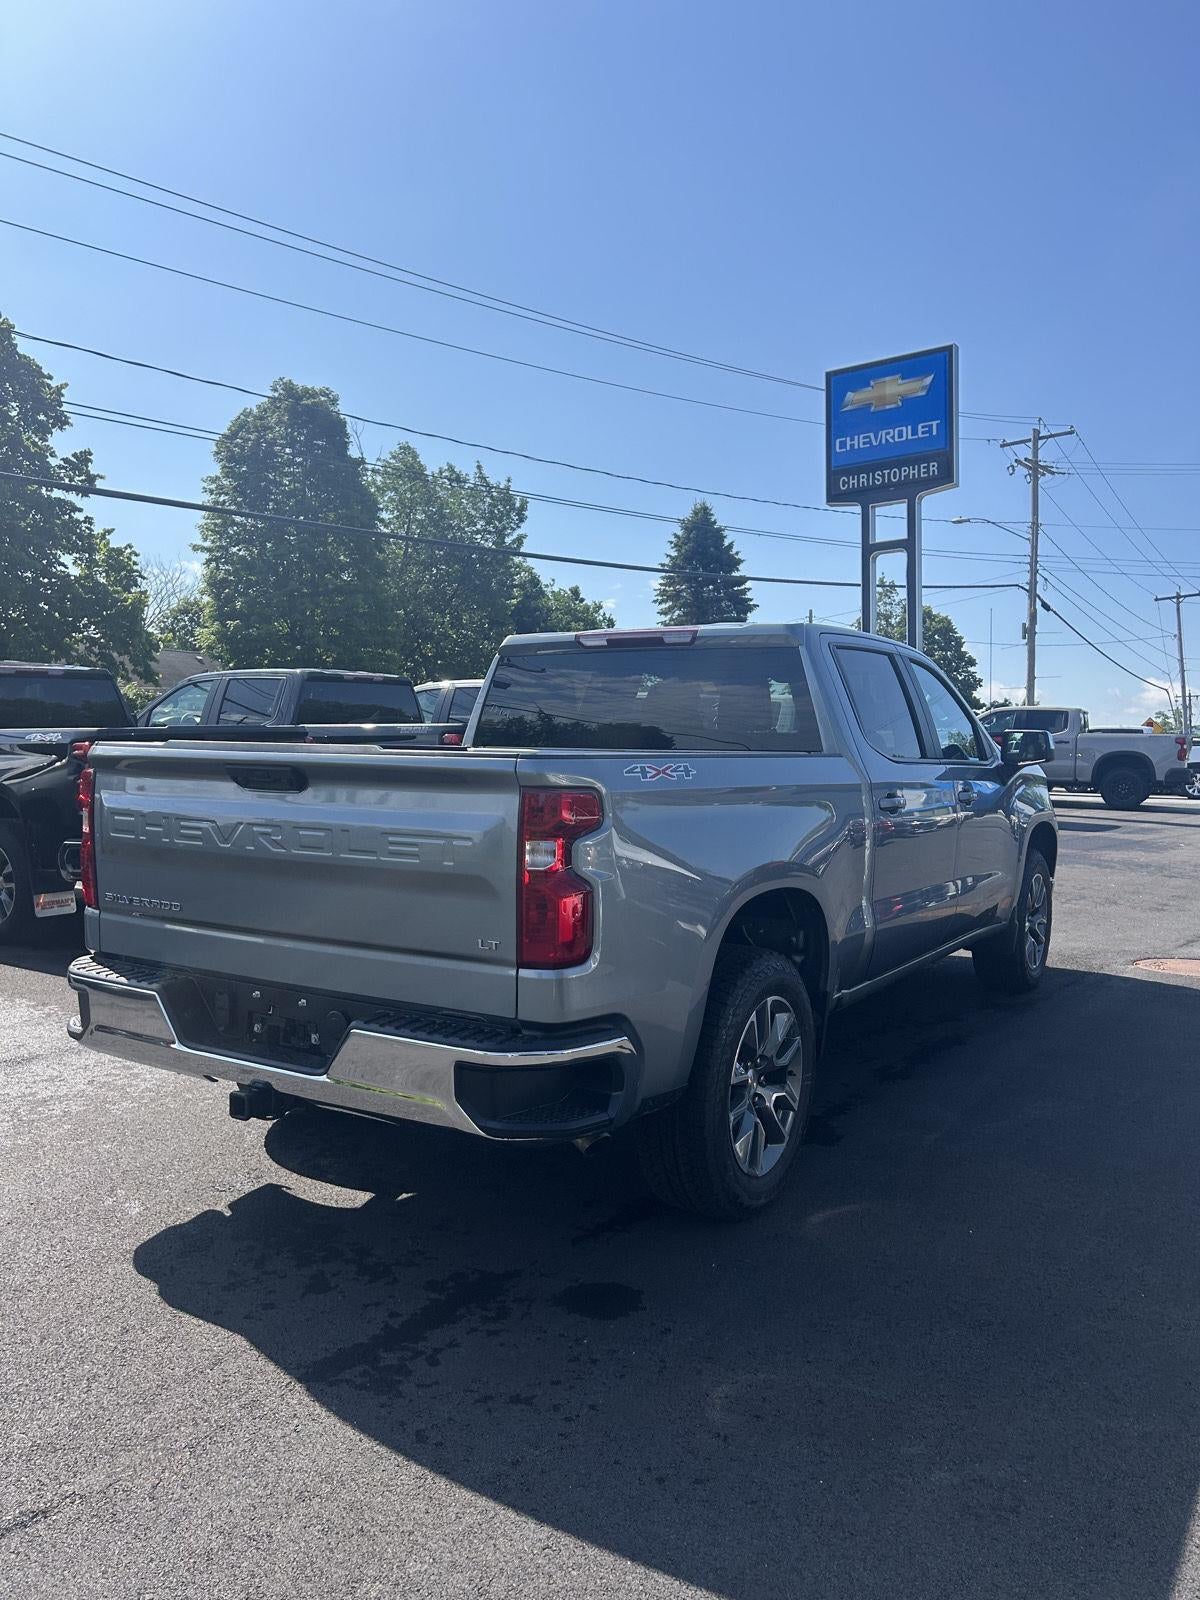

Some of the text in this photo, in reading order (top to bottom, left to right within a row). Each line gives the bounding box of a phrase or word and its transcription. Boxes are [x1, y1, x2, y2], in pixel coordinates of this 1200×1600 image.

[835, 420, 940, 453] CHEVROLET
[839, 461, 938, 490] CHRISTOPHER
[107, 810, 474, 866] CHEVROLET
[104, 892, 182, 911] SILVERADO
[478, 938, 500, 951] LT
